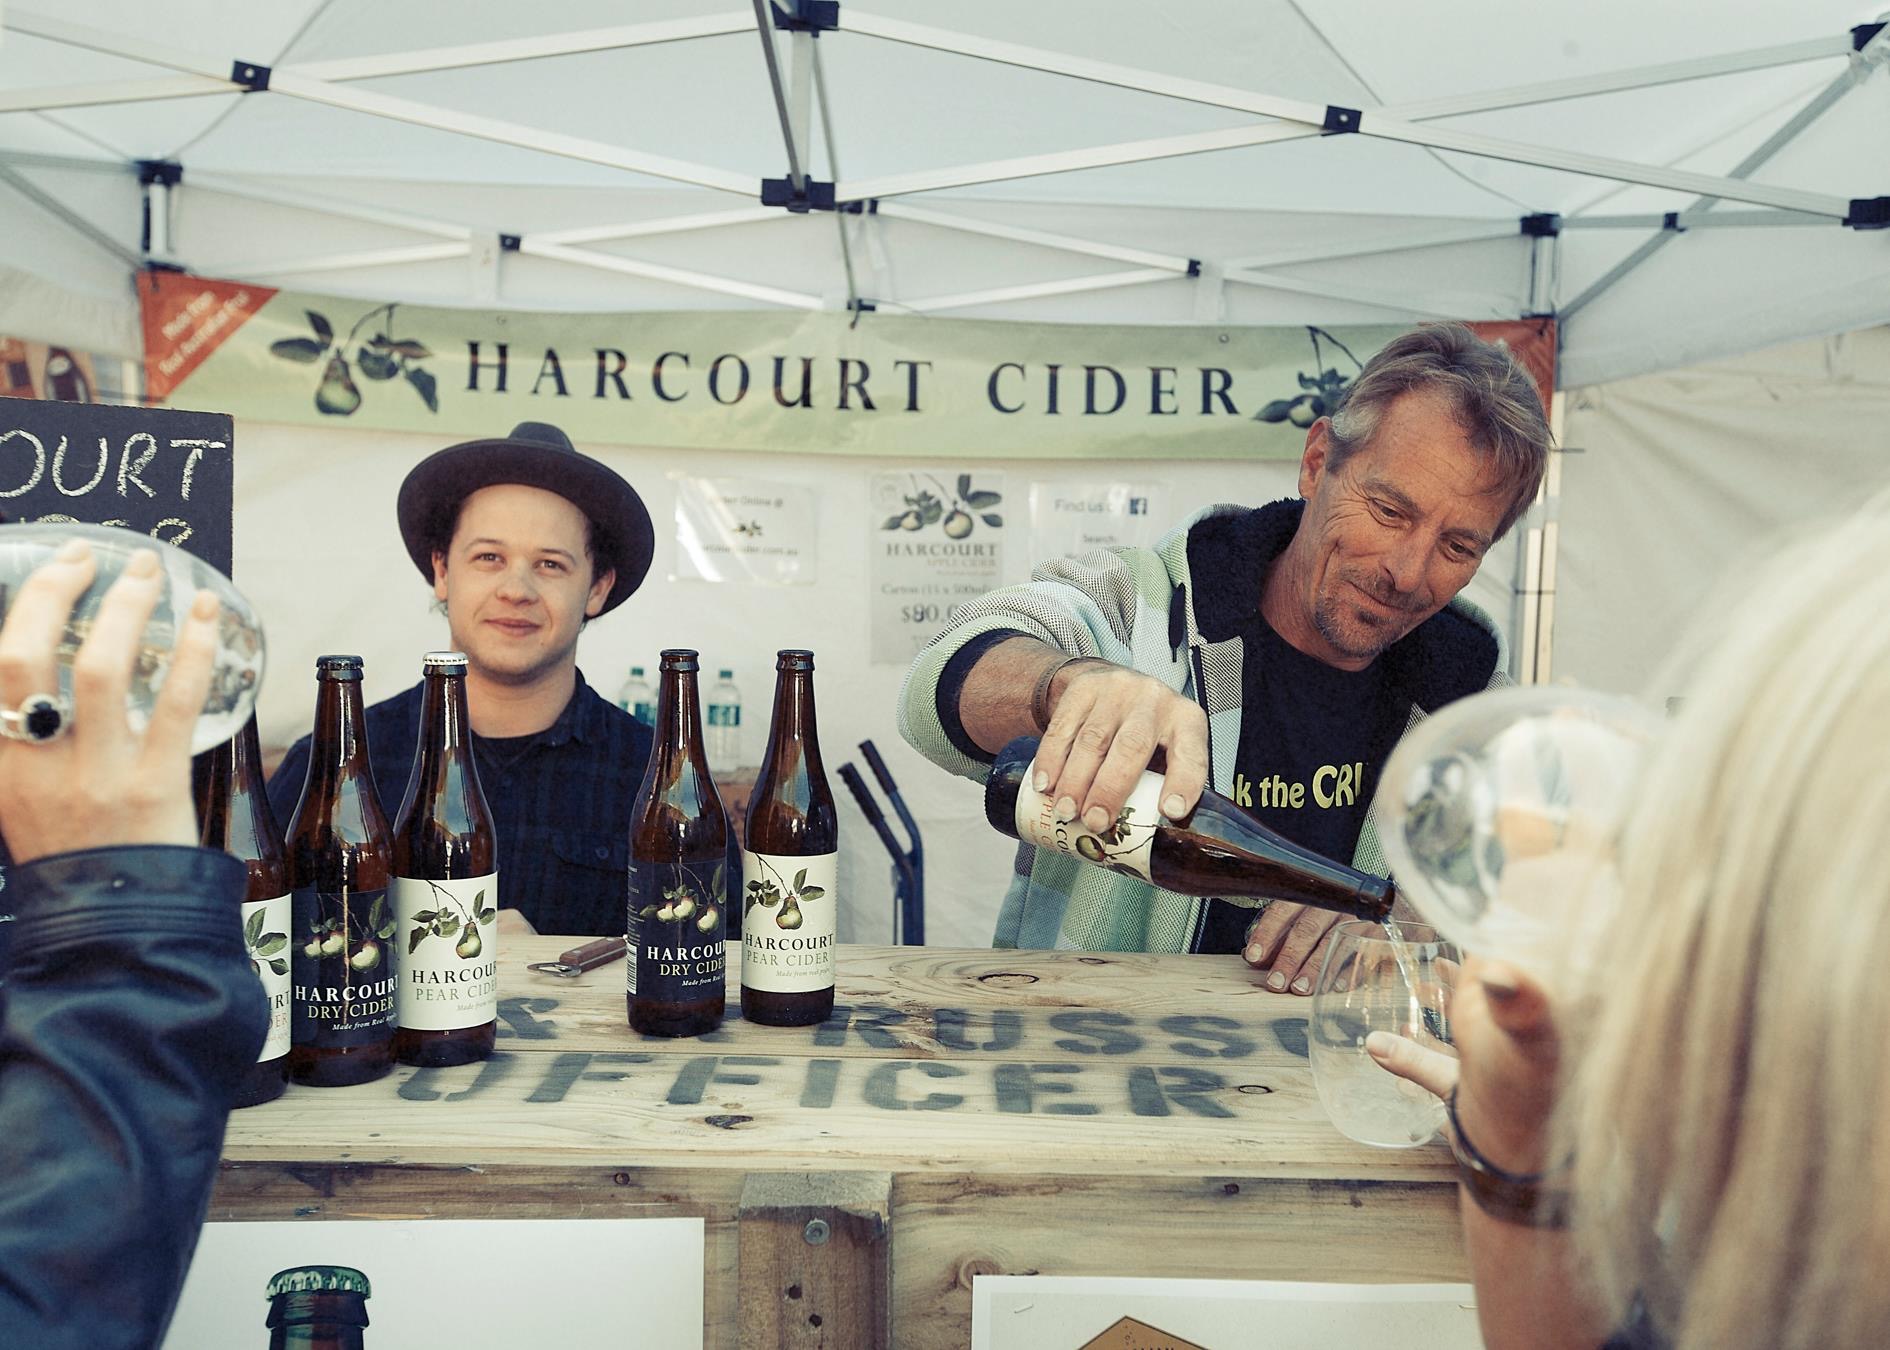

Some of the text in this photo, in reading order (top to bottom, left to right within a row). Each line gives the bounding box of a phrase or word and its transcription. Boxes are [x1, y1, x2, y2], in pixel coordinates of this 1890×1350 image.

[466, 340, 1240, 416] HARCOURT CIDER
[1055, 499, 1085, 512] Find
[887, 543, 997, 557] HARCOURT
[1232, 774, 1252, 807] k
[1259, 775, 1305, 809] the
[745, 933, 834, 950] HARCOURT
[747, 950, 829, 967] PEAR CIDER
[660, 964, 691, 976] DRY
[295, 974, 399, 1002] HARCOURT
[682, 979, 699, 987] Made
[416, 988, 459, 1001] PEAR
[308, 996, 394, 1019] DRY CIDER
[332, 1022, 352, 1031] Made
[353, 1020, 370, 1031] from
